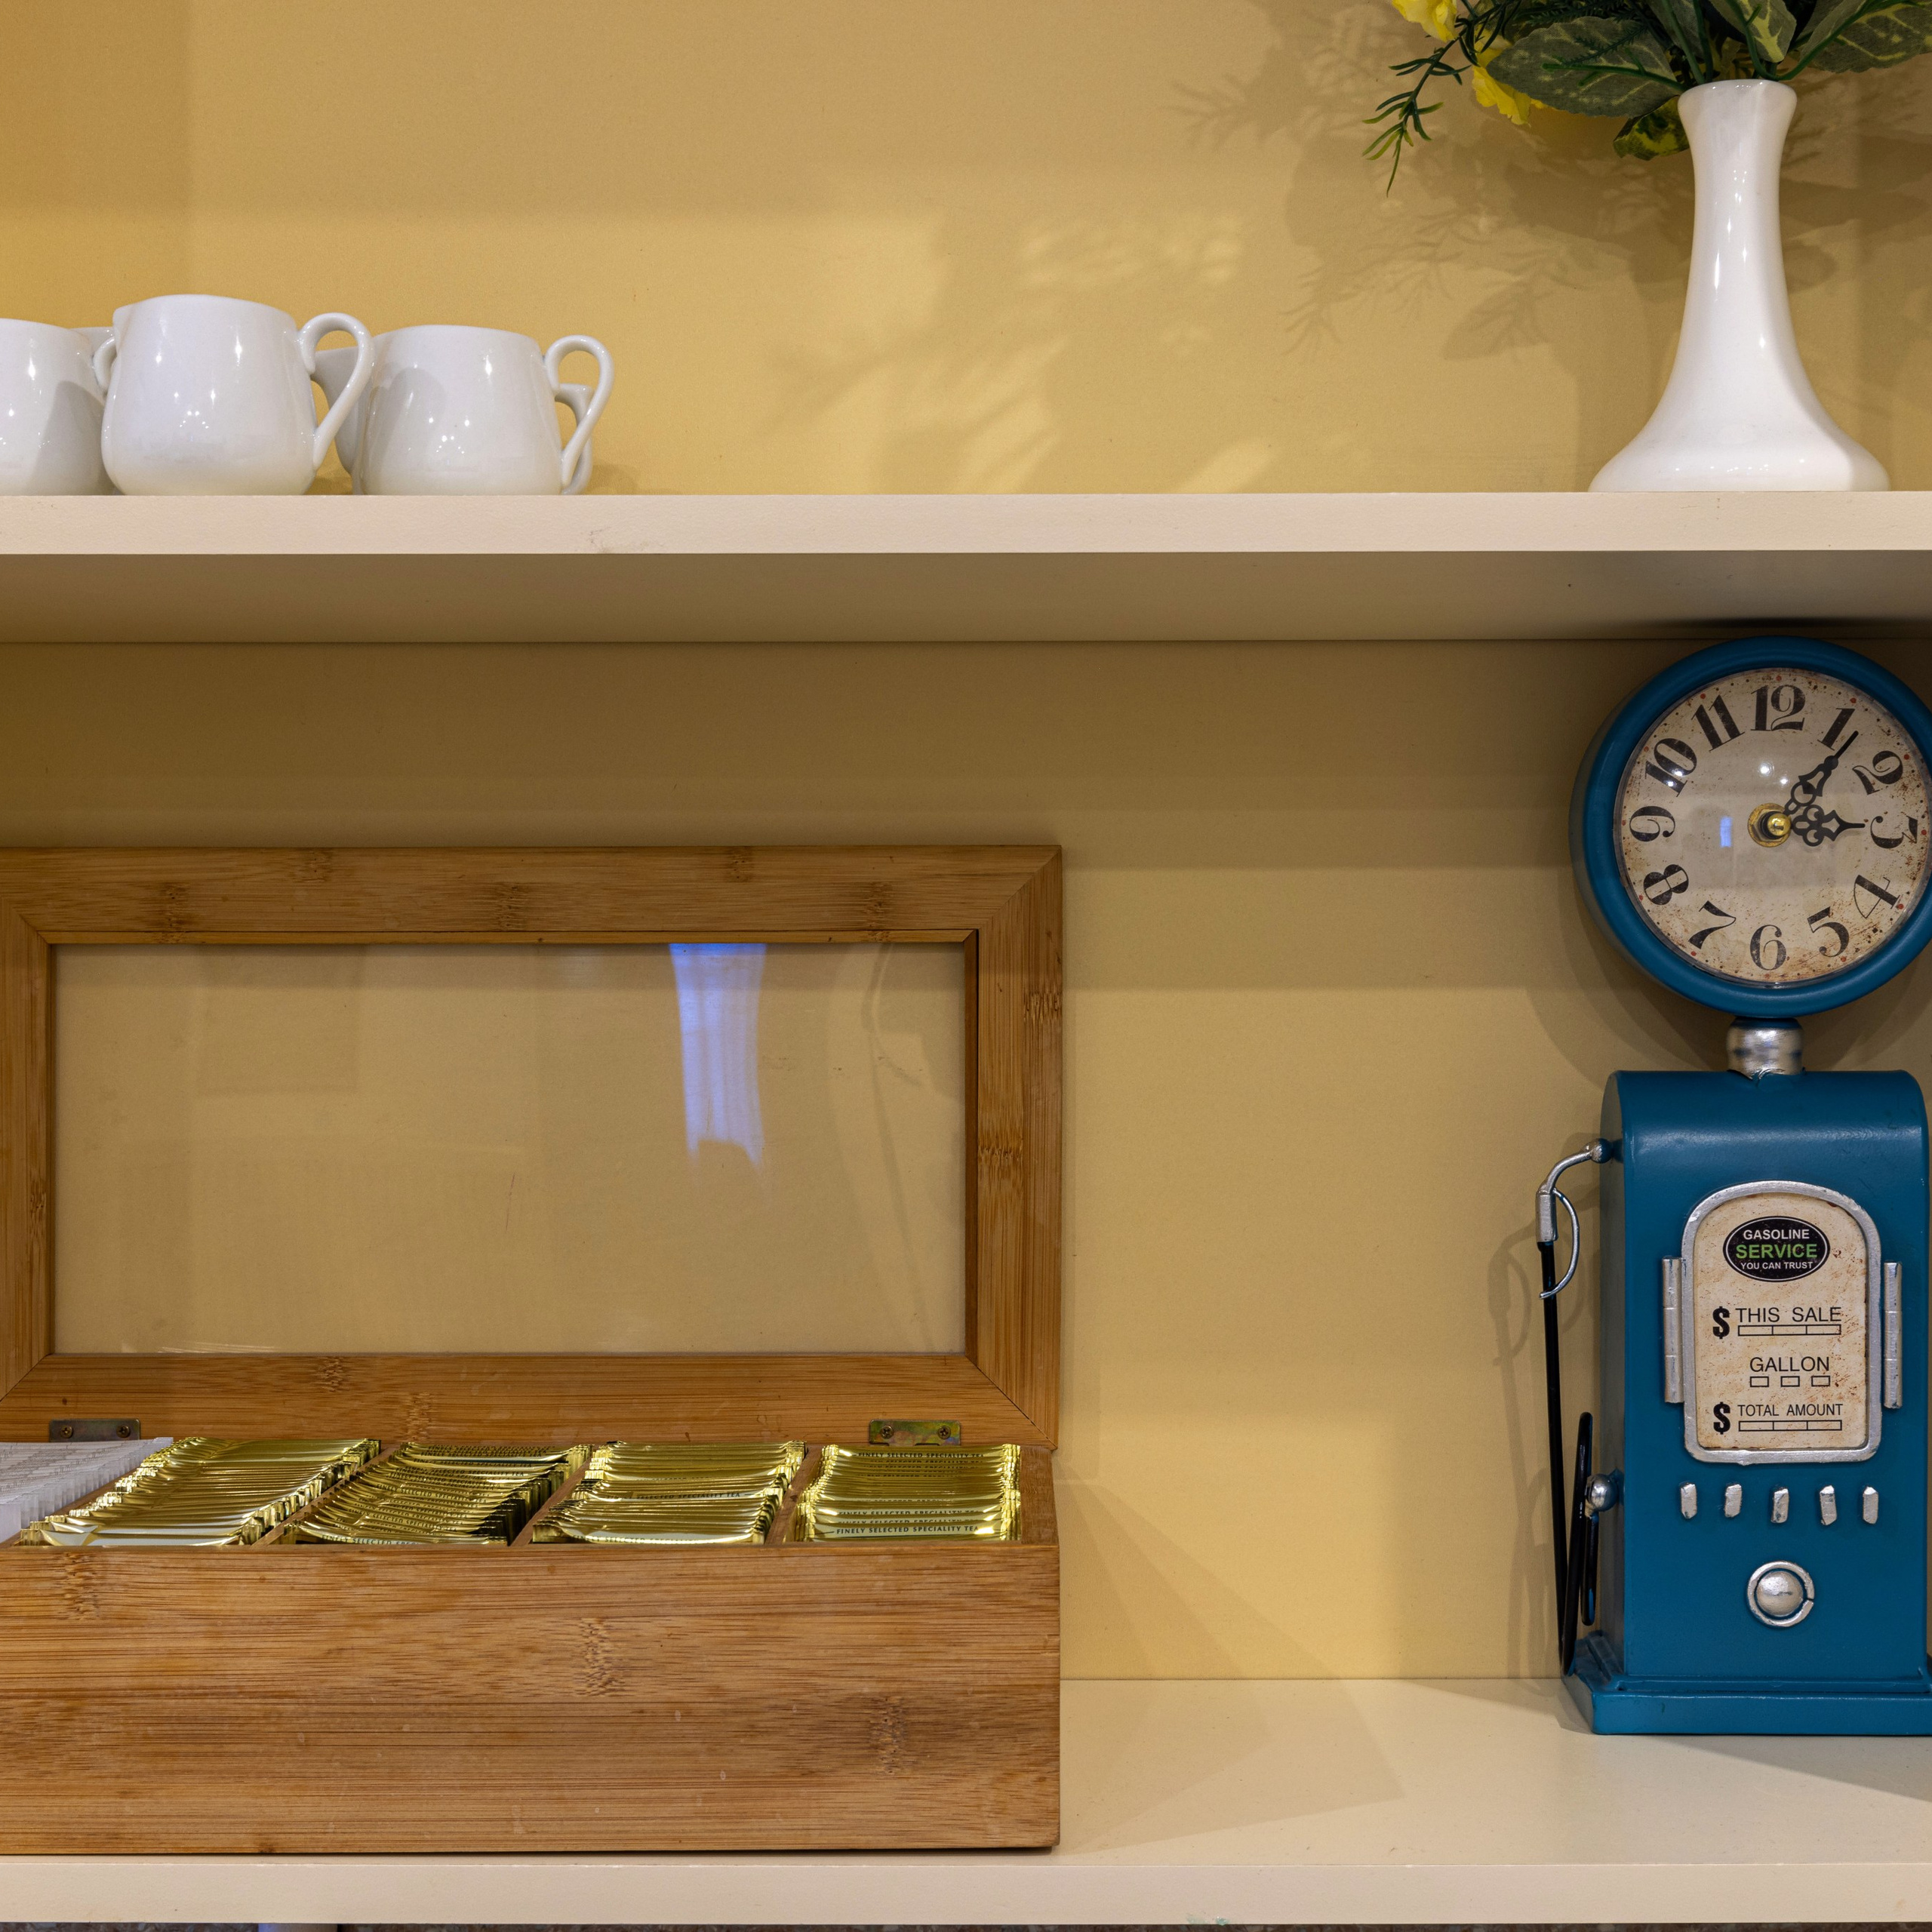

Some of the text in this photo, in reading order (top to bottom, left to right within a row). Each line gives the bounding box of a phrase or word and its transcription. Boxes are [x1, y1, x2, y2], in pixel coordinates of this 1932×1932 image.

[1691, 695, 1745, 752] 11
[1750, 685, 1806, 731] 12
[1817, 707, 1856, 750] 1
[1645, 738, 1697, 797] 10
[1853, 750, 1903, 795] 2
[1629, 805, 1675, 842] 9
[1870, 816, 1918, 848] 3
[1644, 864, 1689, 905] 8
[1854, 875, 1900, 918] 4
[1687, 900, 1737, 949] 7
[1807, 906, 1850, 957] 5
[1749, 924, 1786, 970] 6
[1736, 1244, 1817, 1259] SERVICE
[1743, 1229, 1810, 1240] GASOLINE
[1712, 1306, 1841, 1340] $ THIS SALE
[1749, 1356, 1829, 1372] GALLON
[1713, 1401, 1843, 1435] $ TOTAL AMOUNT
[401, 1488, 432, 1497] SELECTED
